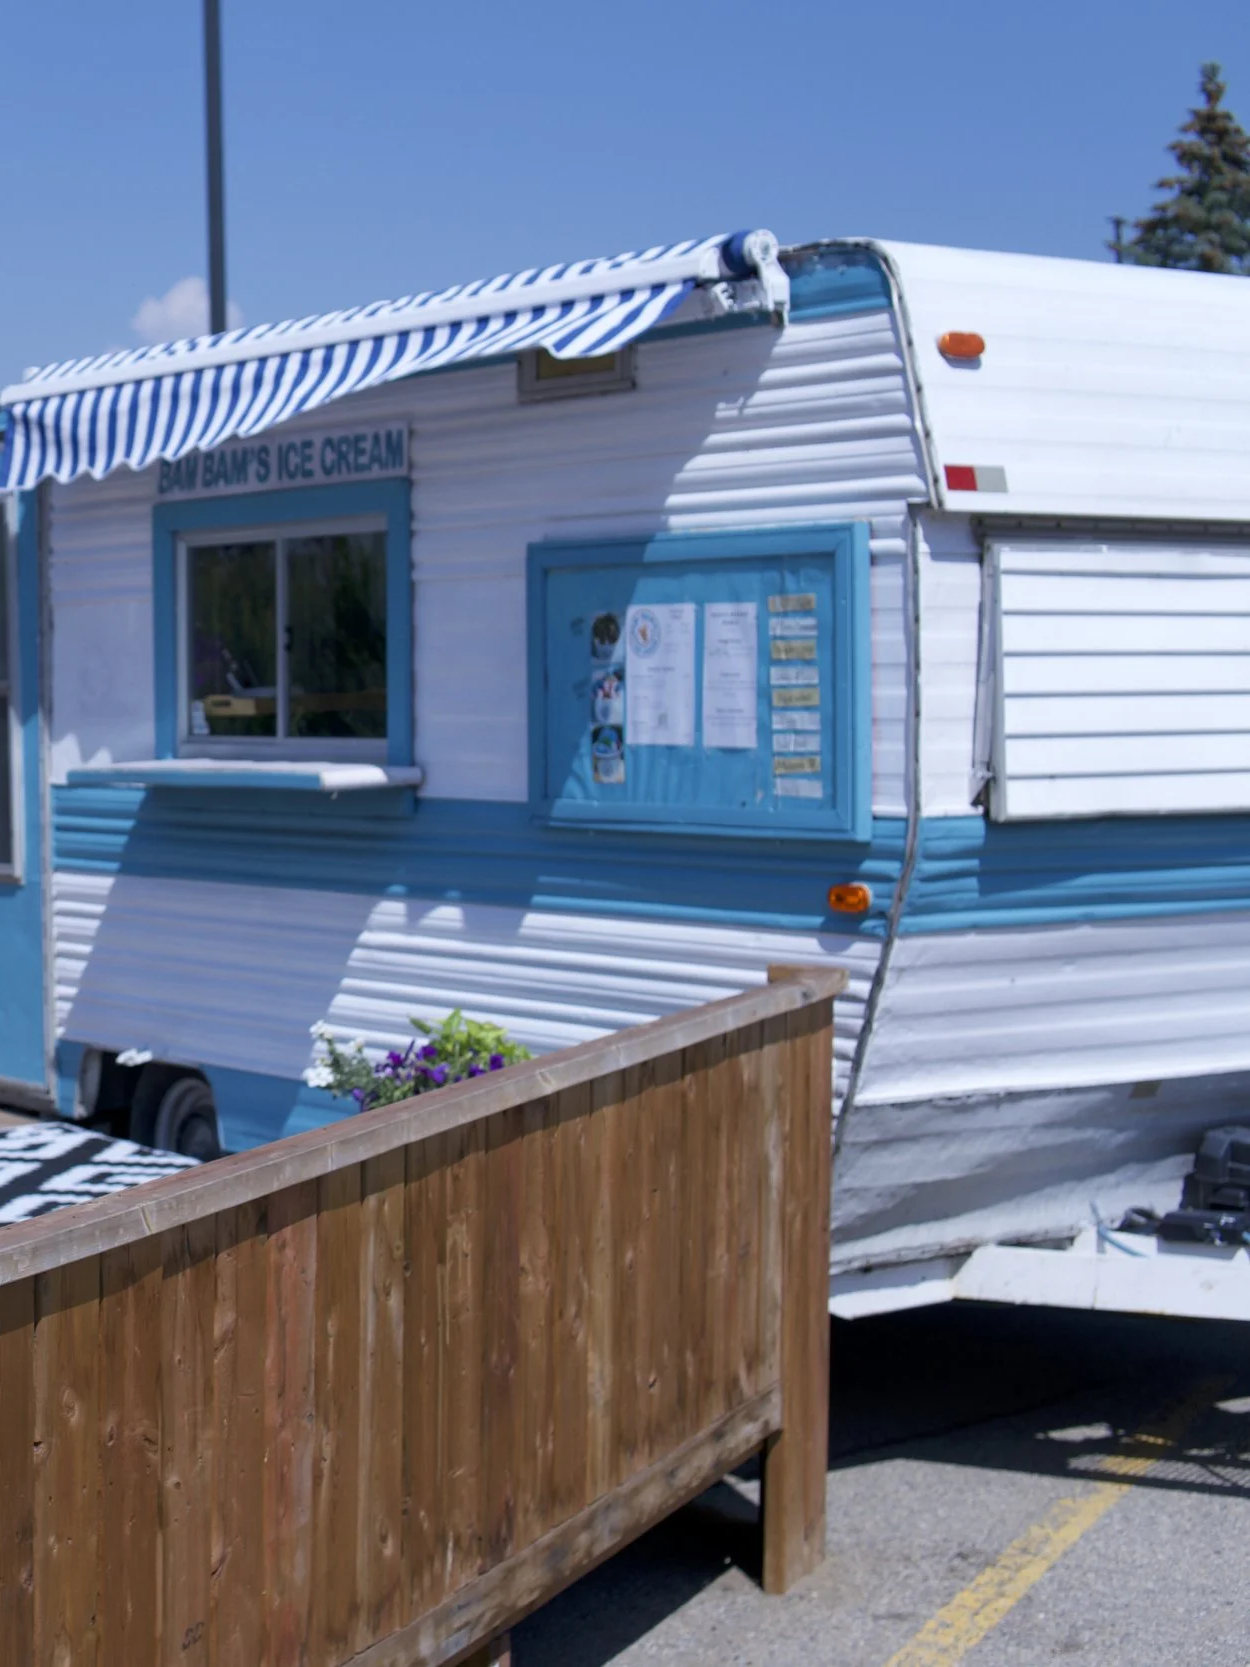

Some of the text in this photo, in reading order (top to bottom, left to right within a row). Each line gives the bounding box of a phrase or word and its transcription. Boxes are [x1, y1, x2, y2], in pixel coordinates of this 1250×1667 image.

[202, 445, 270, 488] BAM'S
[278, 439, 314, 480] ICE
[321, 429, 404, 476] CREAM
